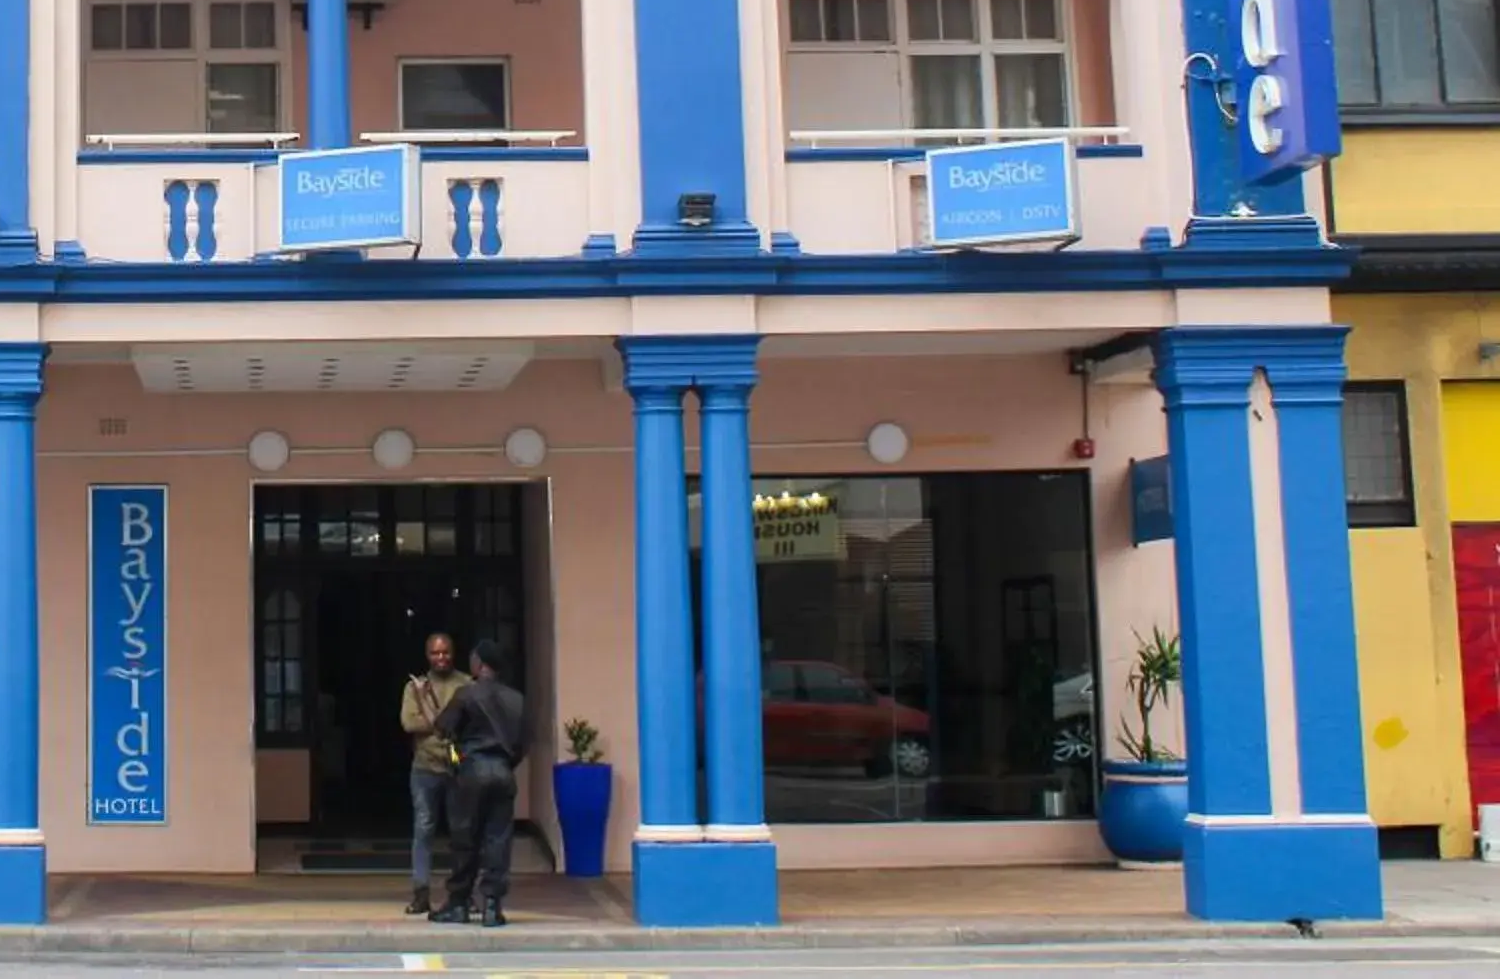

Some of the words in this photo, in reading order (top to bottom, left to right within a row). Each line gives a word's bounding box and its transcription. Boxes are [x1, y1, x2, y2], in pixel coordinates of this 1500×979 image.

[296, 165, 386, 199] Bayside
[949, 159, 1047, 193] Bayside
[113, 502, 157, 793] Bayside
[94, 798, 161, 815] HOTEL
